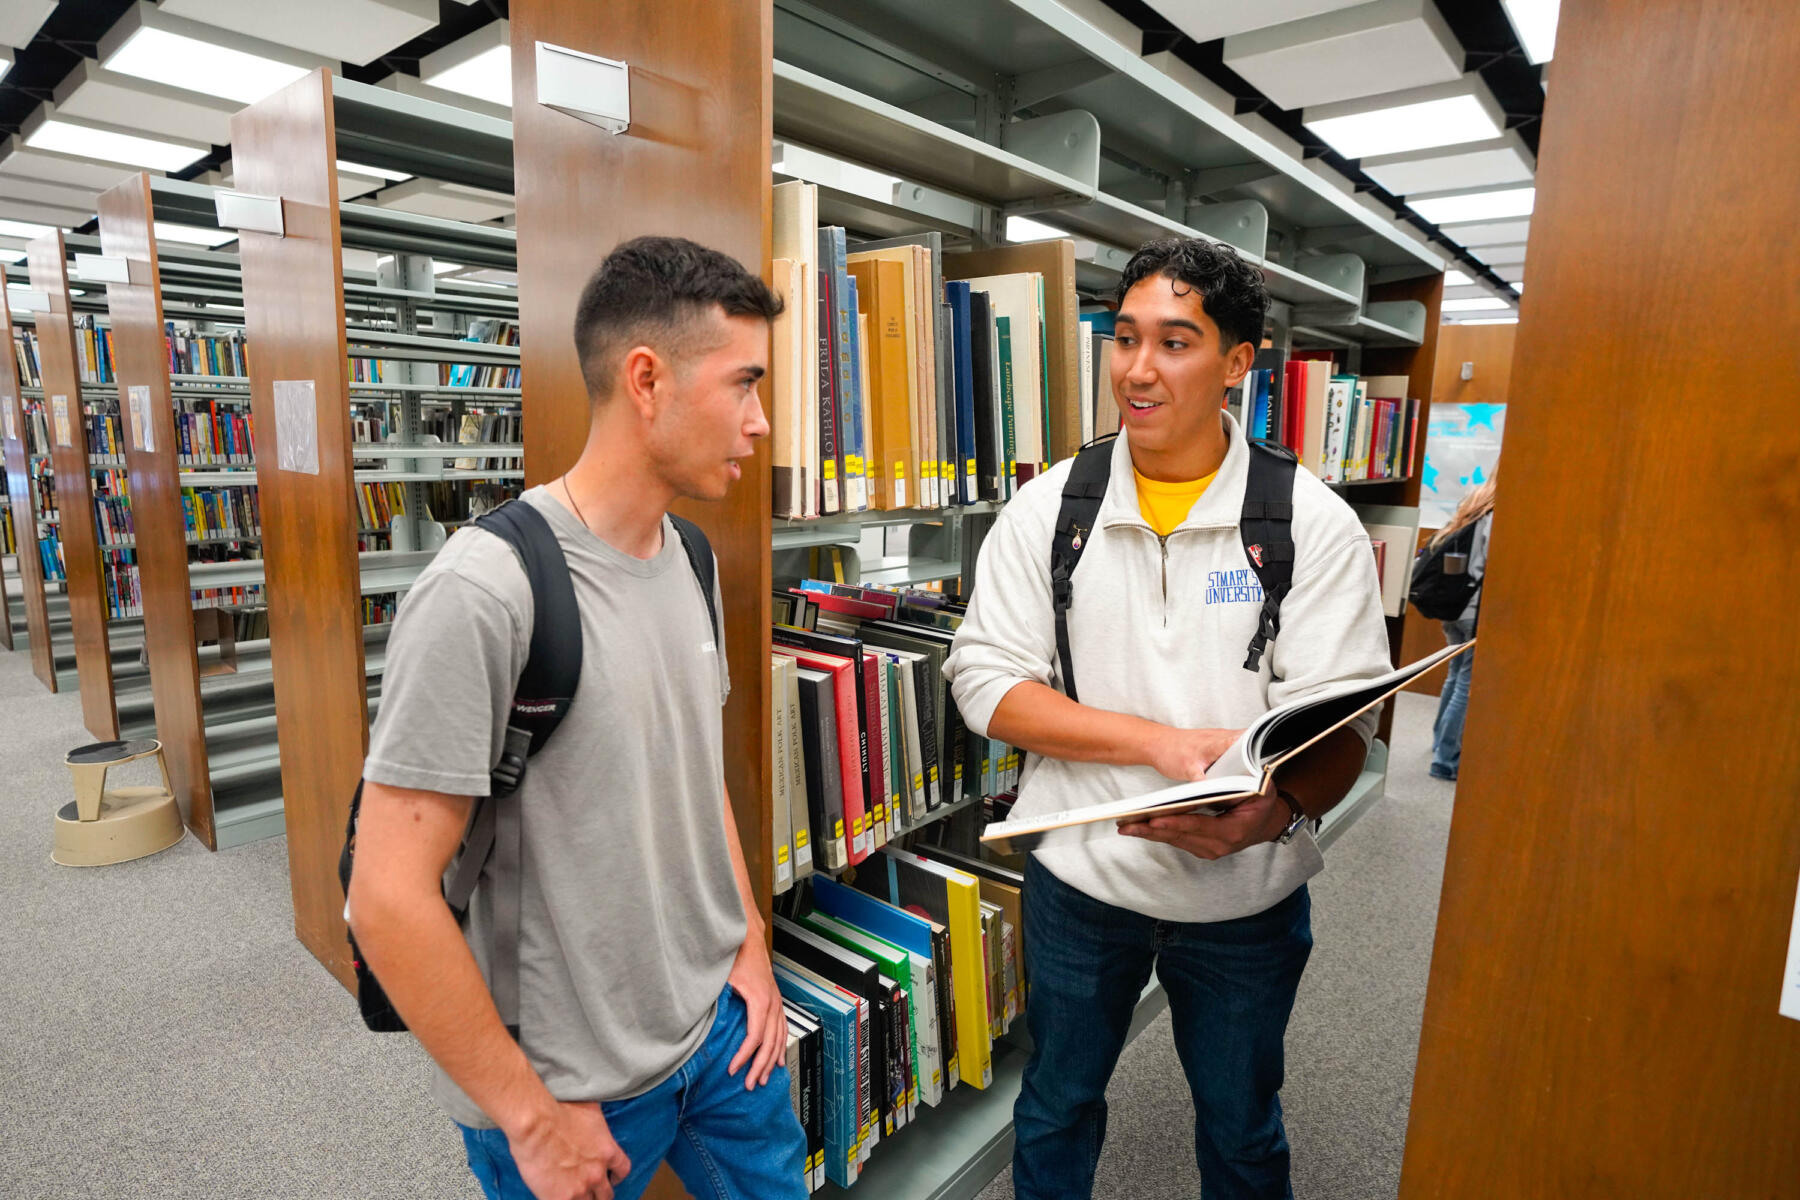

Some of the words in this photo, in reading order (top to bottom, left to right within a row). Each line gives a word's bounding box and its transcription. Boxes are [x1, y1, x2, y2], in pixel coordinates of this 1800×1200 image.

[819, 337, 830, 390] FRIDA
[1004, 361, 1014, 412] Landscape
[822, 396, 834, 453] KAHLO
[793, 748, 801, 787] MEXICAN
[860, 731, 868, 773] CHIHULY
[860, 1018, 869, 1051] DRUNK
[860, 1050, 869, 1085] STONED
[802, 1085, 811, 1125] Keaton
[861, 1083, 870, 1127] BRILLIANT
